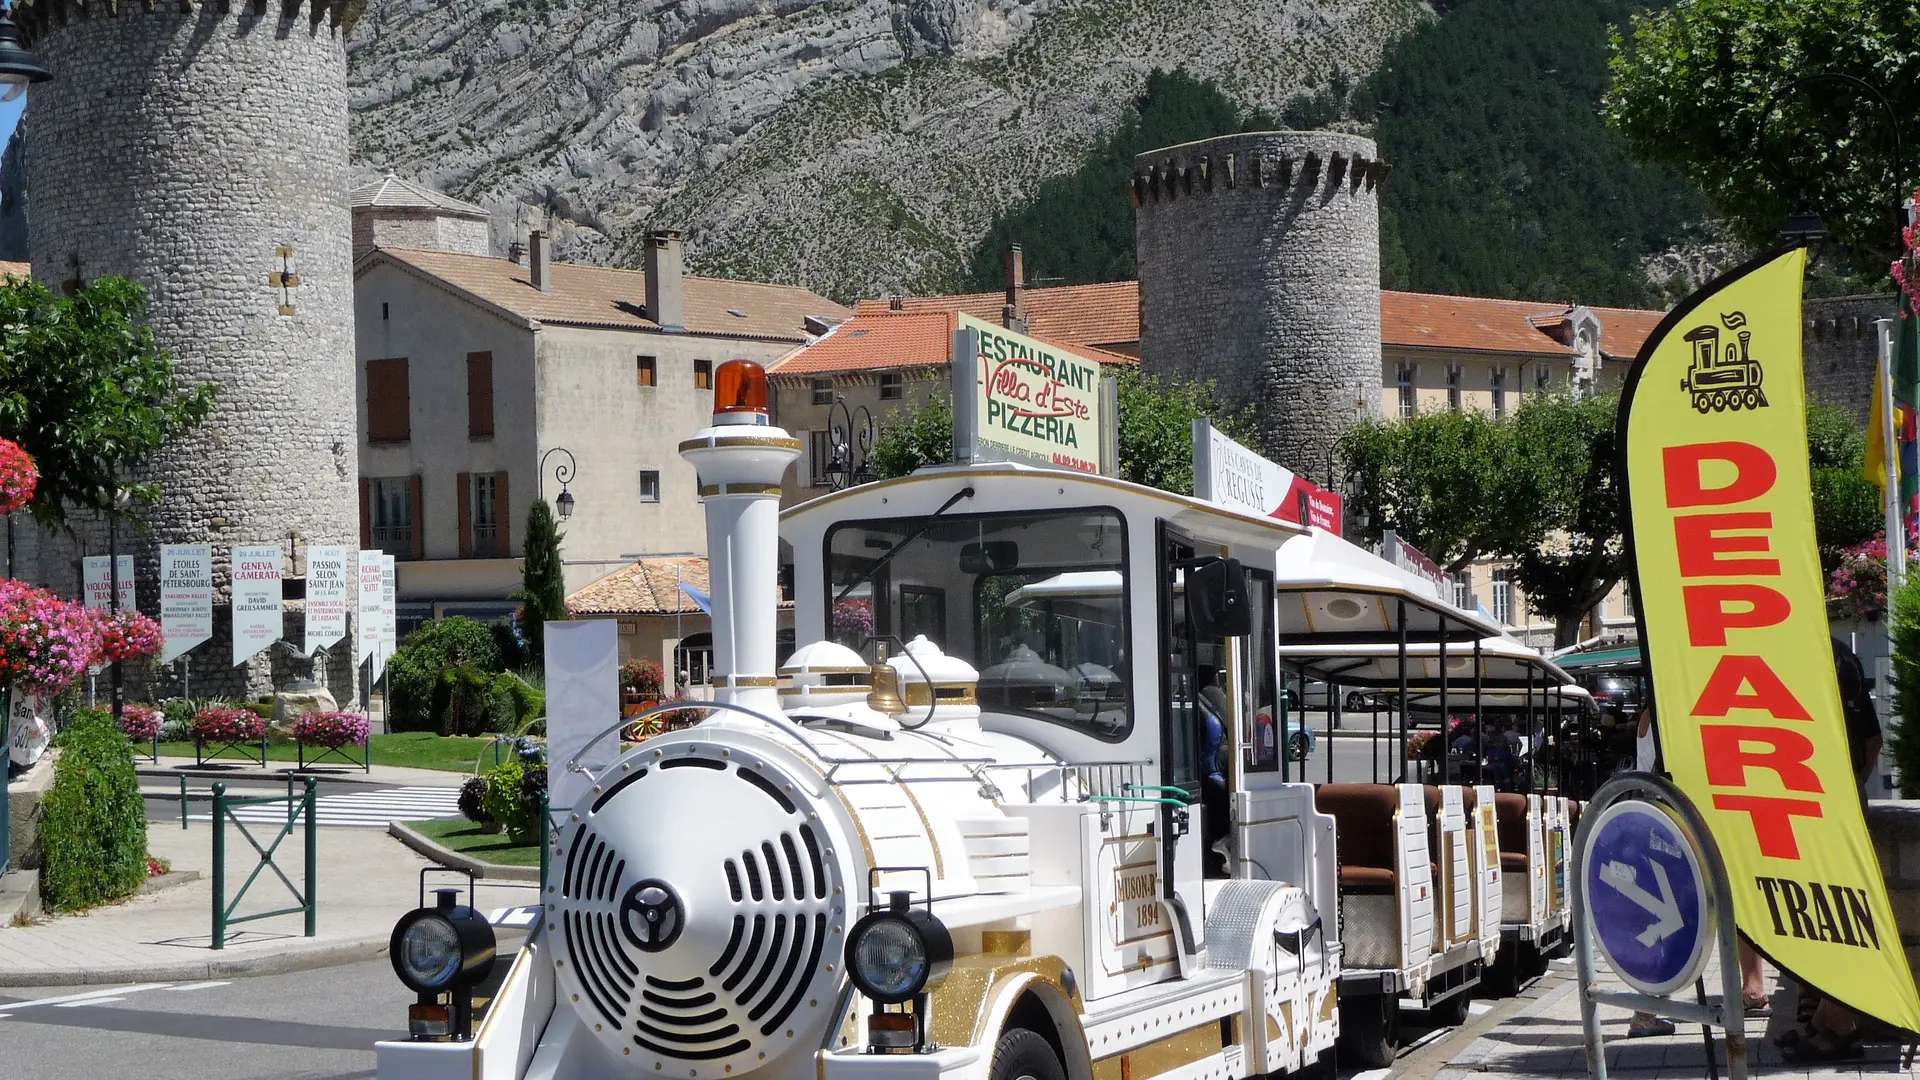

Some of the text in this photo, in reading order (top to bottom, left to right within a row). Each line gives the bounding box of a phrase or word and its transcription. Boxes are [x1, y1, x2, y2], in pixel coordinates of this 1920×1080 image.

[1035, 380, 1091, 421] d'Este
[987, 398, 1079, 449] PIZZERIA
[1224, 445, 1263, 483] LES CAVES DE
[1226, 468, 1266, 513] REGUSSE
[176, 548, 206, 556] JUILLET
[100, 560, 128, 568] JUIET
[173, 559, 200, 569] ÉTOILES
[241, 561, 273, 570] GENEVA
[312, 560, 341, 569] PASSION
[170, 570, 204, 579] DE SAINT-
[316, 570, 338, 579] SELON
[361, 565, 380, 574] RICHARD
[103, 572, 112, 581] LE
[234, 571, 281, 580] CAMERATA
[86, 580, 133, 591] VIOLONLLES
[309, 579, 345, 590] SAINT JEAN
[364, 583, 378, 593] SEXTET
[94, 591, 128, 601] FRANIS
[1662, 441, 1825, 860] DEPART
[1136, 902, 1159, 929] 1894
[1755, 875, 1882, 951] TRAIN
